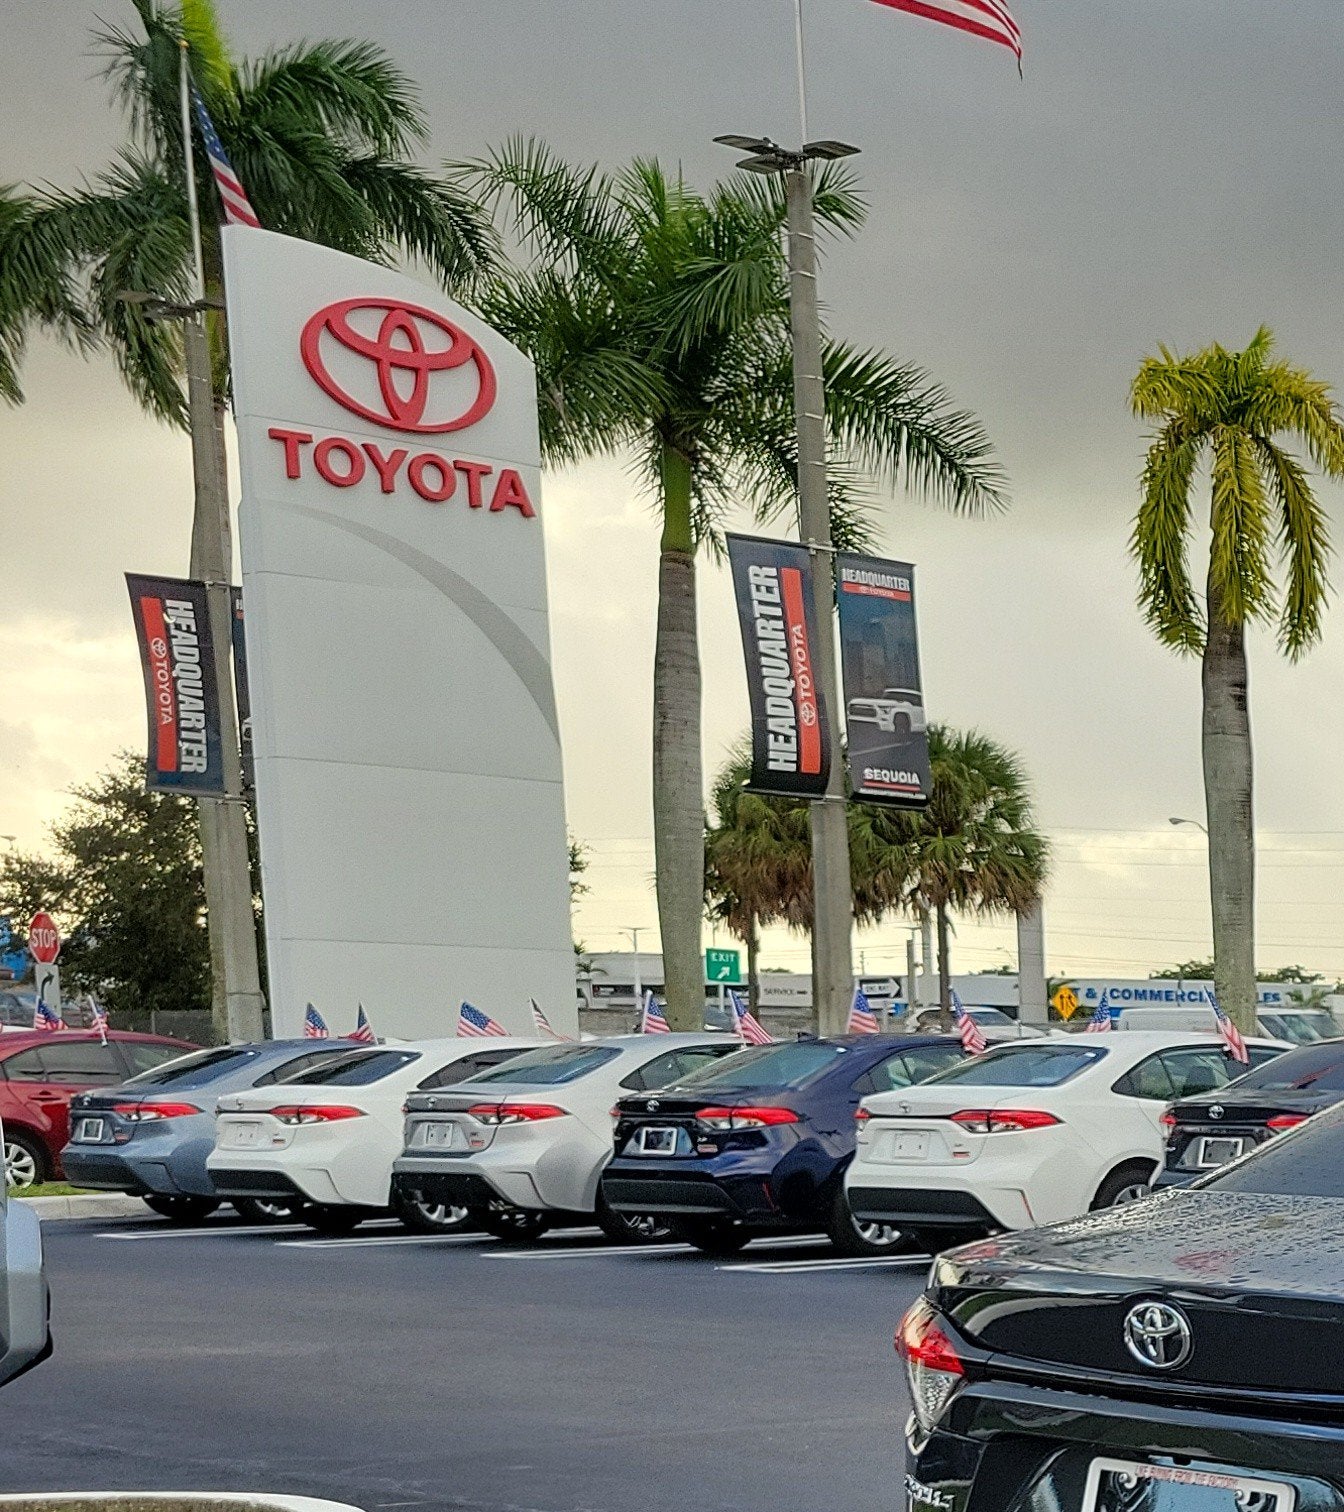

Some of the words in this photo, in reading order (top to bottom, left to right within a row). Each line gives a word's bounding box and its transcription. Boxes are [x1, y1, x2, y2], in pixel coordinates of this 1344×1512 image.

[268, 427, 535, 518] TOYOTA
[841, 568, 910, 591] HEADQUARTER
[748, 564, 797, 773] HEADQUARTER
[791, 624, 818, 700] TOYOTA
[155, 661, 173, 725] TOYOTA
[164, 598, 208, 774] HEADQUARTER
[864, 767, 921, 785] SEQUOIA
[31, 928, 57, 948] STOP
[710, 952, 736, 962] EXIT
[1085, 987, 1097, 999] &
[1110, 987, 1214, 1002] COMMERCI
